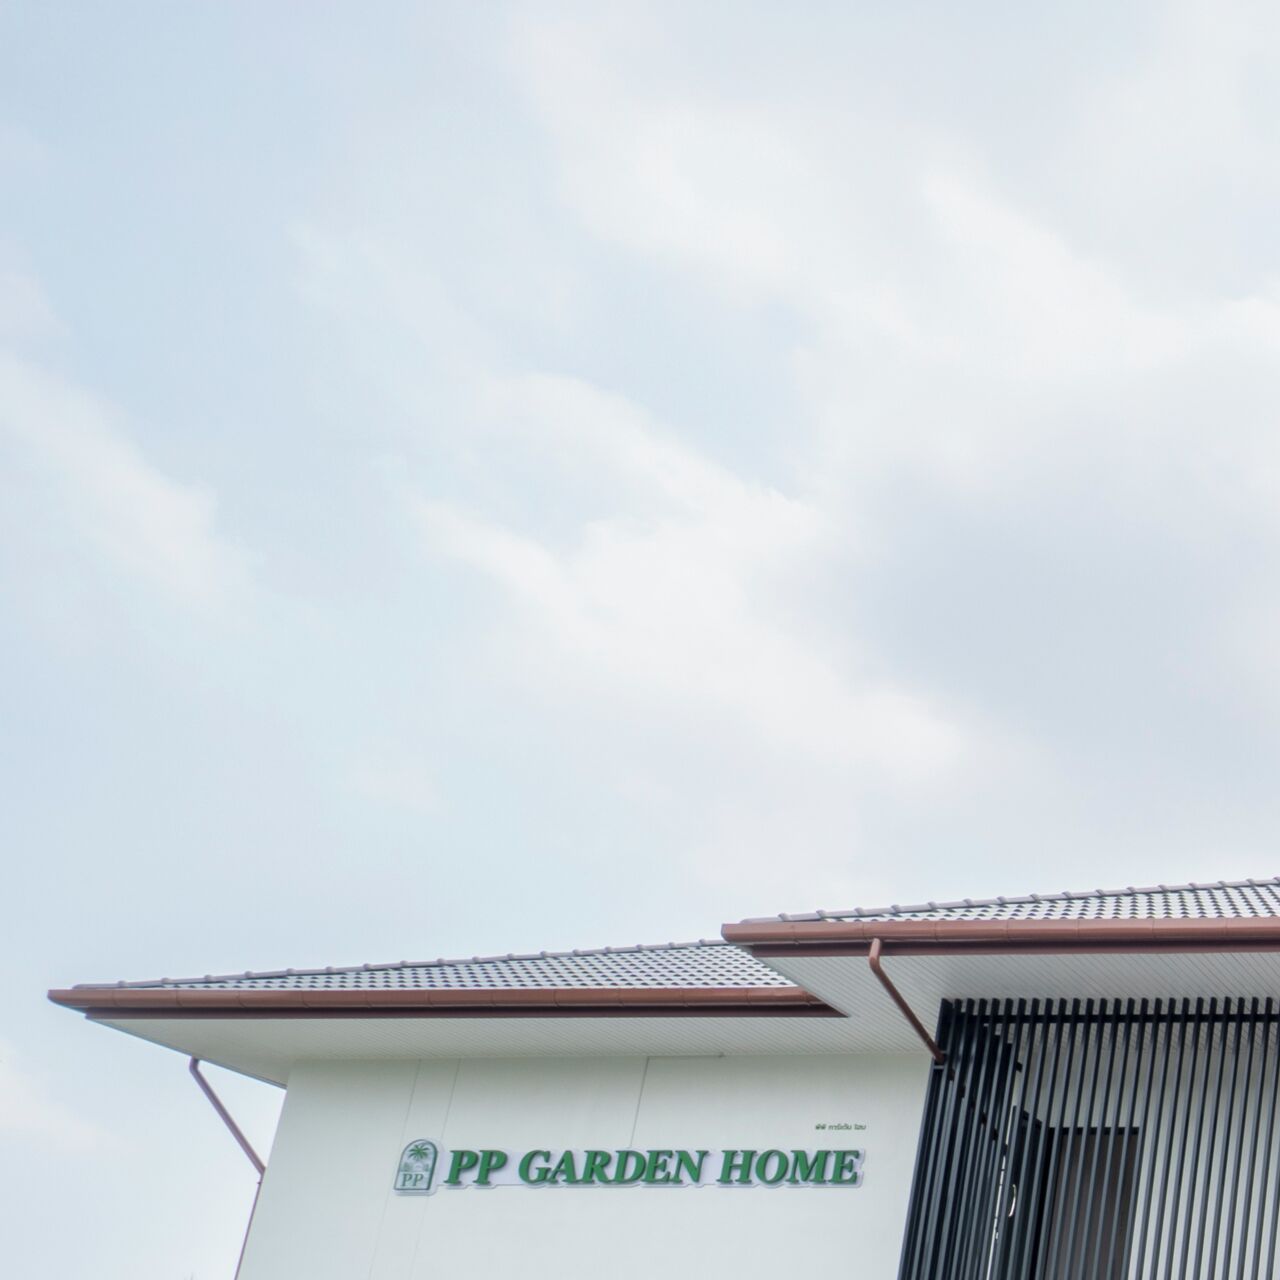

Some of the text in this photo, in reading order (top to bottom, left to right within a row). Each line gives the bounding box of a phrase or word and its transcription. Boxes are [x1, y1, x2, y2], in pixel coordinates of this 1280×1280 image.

[443, 1149, 861, 1185] PP GARDEN HOME
[401, 1173, 425, 1187] PP
